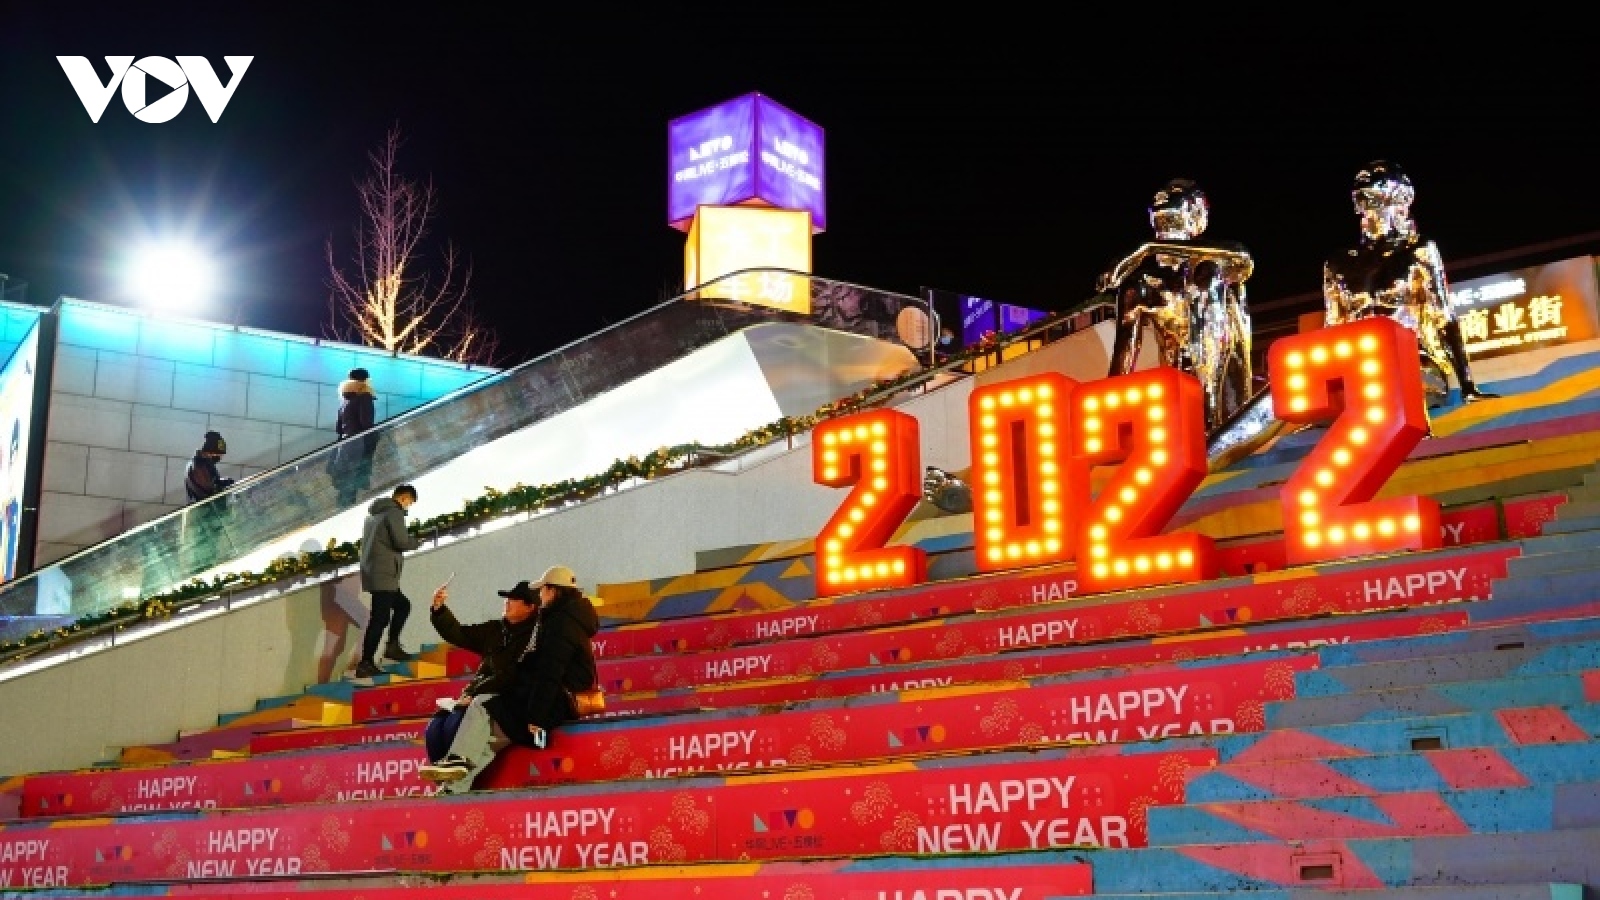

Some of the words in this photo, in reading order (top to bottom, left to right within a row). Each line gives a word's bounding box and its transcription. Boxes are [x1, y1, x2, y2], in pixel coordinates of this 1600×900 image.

[1459, 295, 1563, 341] 商业街
[1032, 580, 1078, 603] HAP
[1364, 567, 1467, 603] HAPPY
[756, 614, 818, 638] HAPPY
[999, 616, 1079, 646] HAPPY
[705, 654, 772, 679] HAPPY
[1071, 684, 1188, 724] HAPPY
[669, 730, 757, 760] HAPPY
[138, 776, 198, 799] HAPPY
[950, 776, 1077, 815] HAPPY
[525, 807, 616, 838] HAPPY
[917, 822, 1001, 854] NEW
[1021, 815, 1128, 850] YEAR
[0, 839, 49, 863] APPY
[208, 827, 279, 853] HAPPY
[246, 857, 301, 876] YEAR
[501, 846, 562, 870] NEW
[576, 841, 649, 868] YEAR
[22, 866, 68, 888] YEAR
